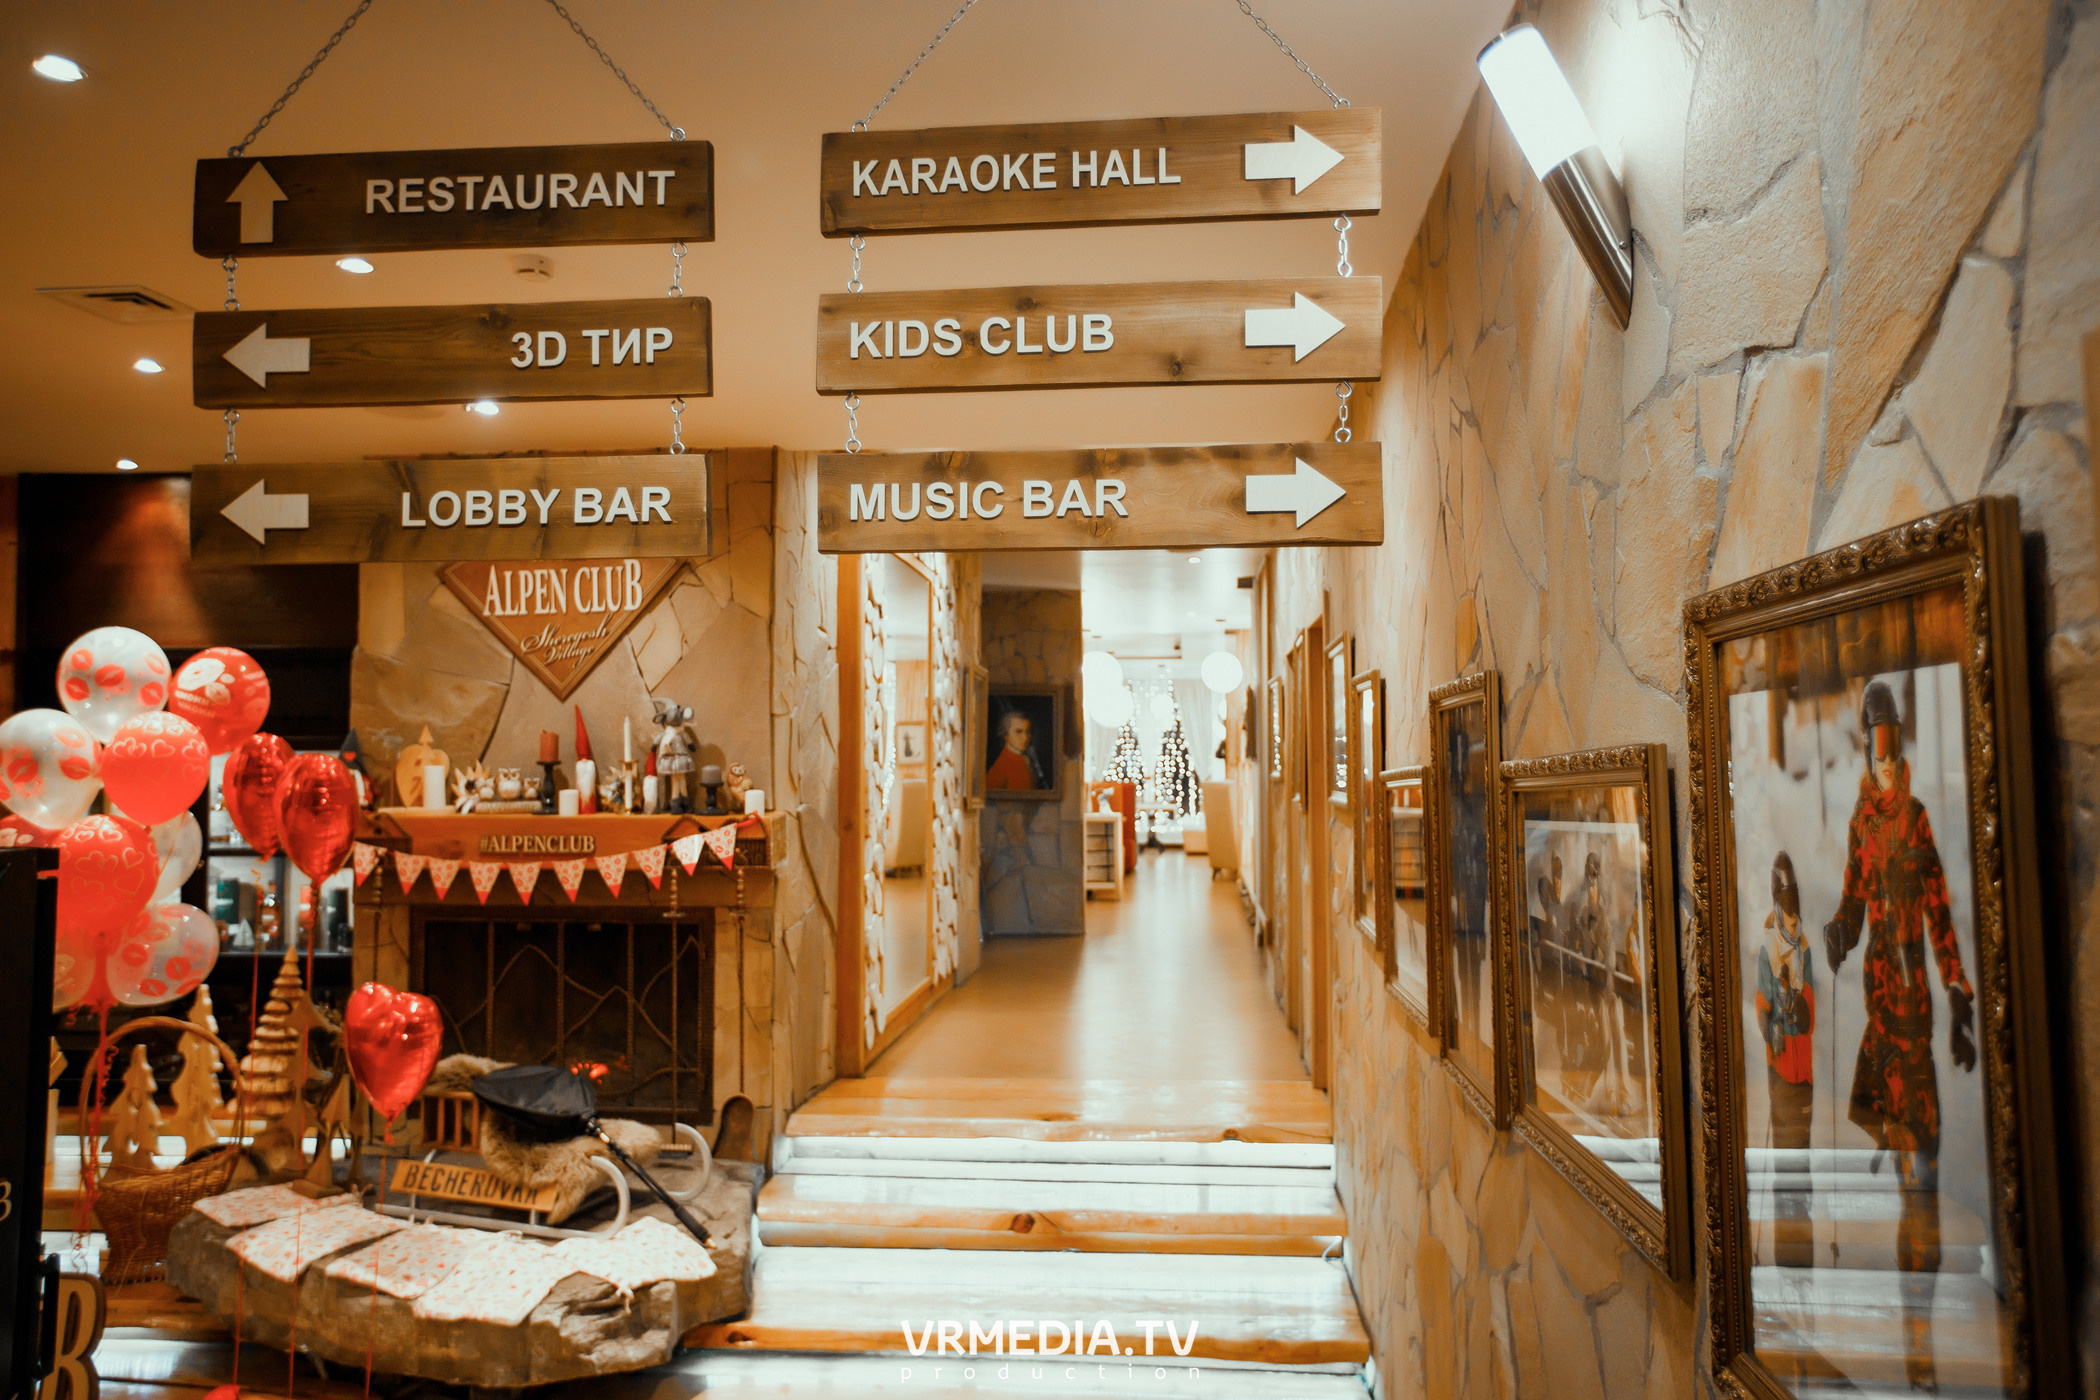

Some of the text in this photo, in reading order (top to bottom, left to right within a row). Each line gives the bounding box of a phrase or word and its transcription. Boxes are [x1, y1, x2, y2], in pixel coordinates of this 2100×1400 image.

[365, 170, 676, 214] RESTAURANT
[852, 147, 1181, 198] KARAOKE HALL
[510, 327, 674, 369] 3D ТИР
[849, 313, 1115, 360] KIDS CLUB
[401, 485, 672, 528] LOBBY BAR
[849, 478, 1129, 522] MUSIC BAR
[483, 558, 643, 616] ALPEN CLUB
[480, 834, 595, 853] #ALPENCLUB
